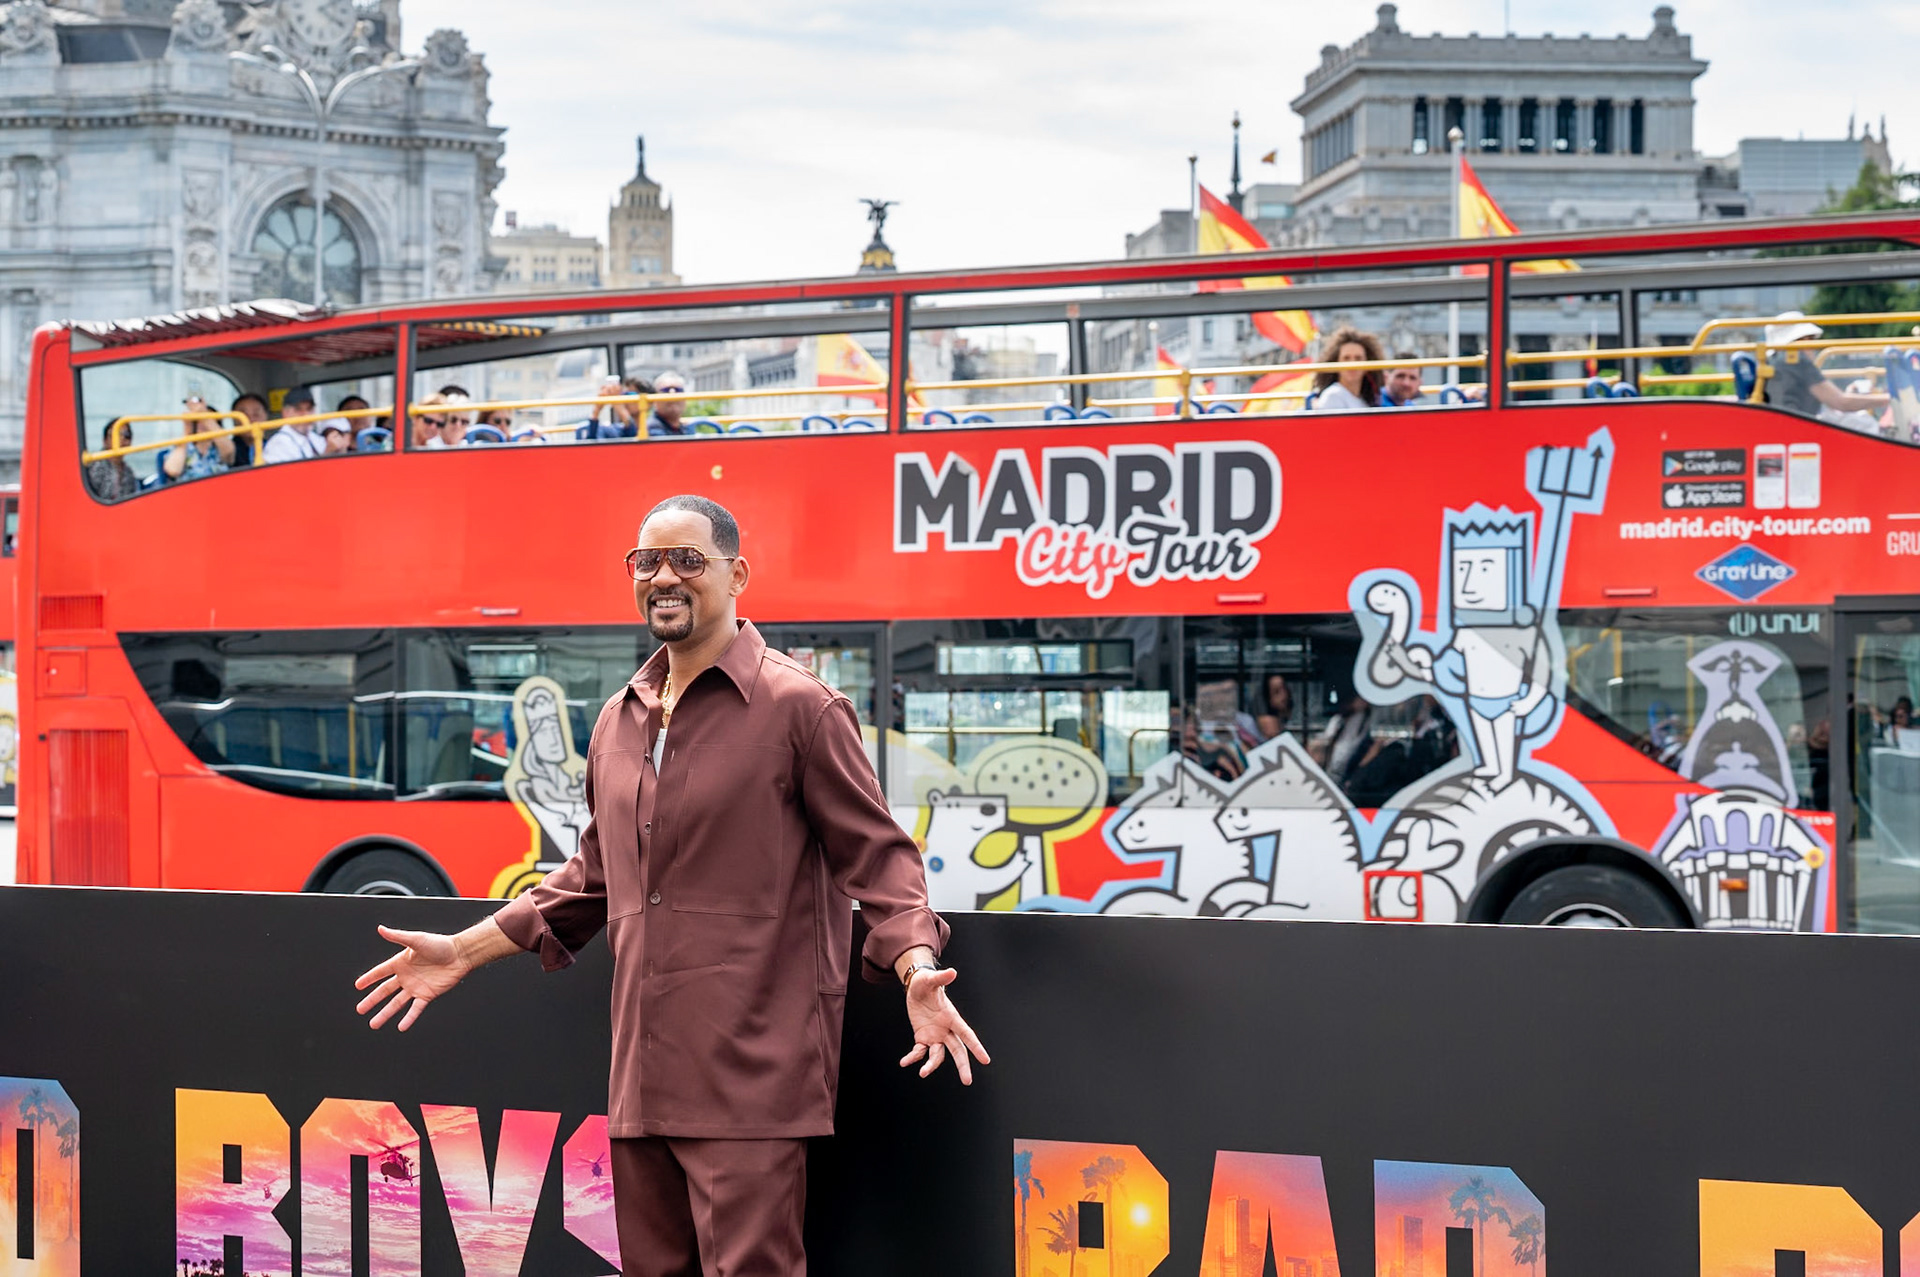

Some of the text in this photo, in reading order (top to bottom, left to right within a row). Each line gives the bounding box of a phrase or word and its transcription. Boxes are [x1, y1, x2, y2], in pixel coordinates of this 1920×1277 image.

[898, 448, 1275, 547] MADRID
[1686, 490, 1742, 506] App Store
[1619, 515, 1871, 540] madrid.city-tour.com
[1021, 521, 1253, 592] City Tour
